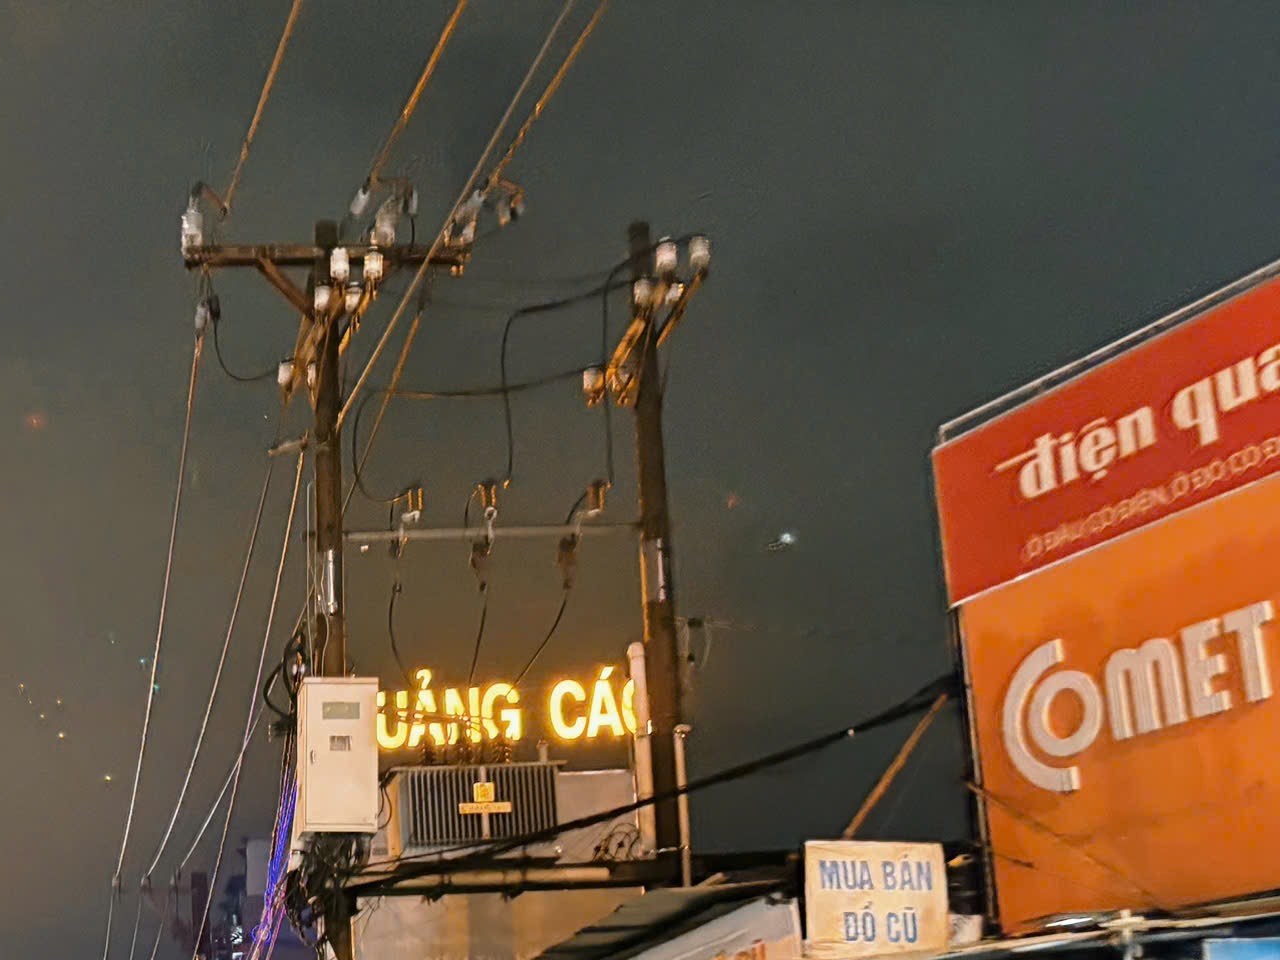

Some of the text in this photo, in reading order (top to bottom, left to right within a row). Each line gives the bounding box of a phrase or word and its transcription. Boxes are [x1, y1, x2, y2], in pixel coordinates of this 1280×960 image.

[1002, 600, 1274, 794] COMET
[819, 853, 933, 892] MUA BÁN
[843, 901, 919, 943] ĐỒ CŨ
